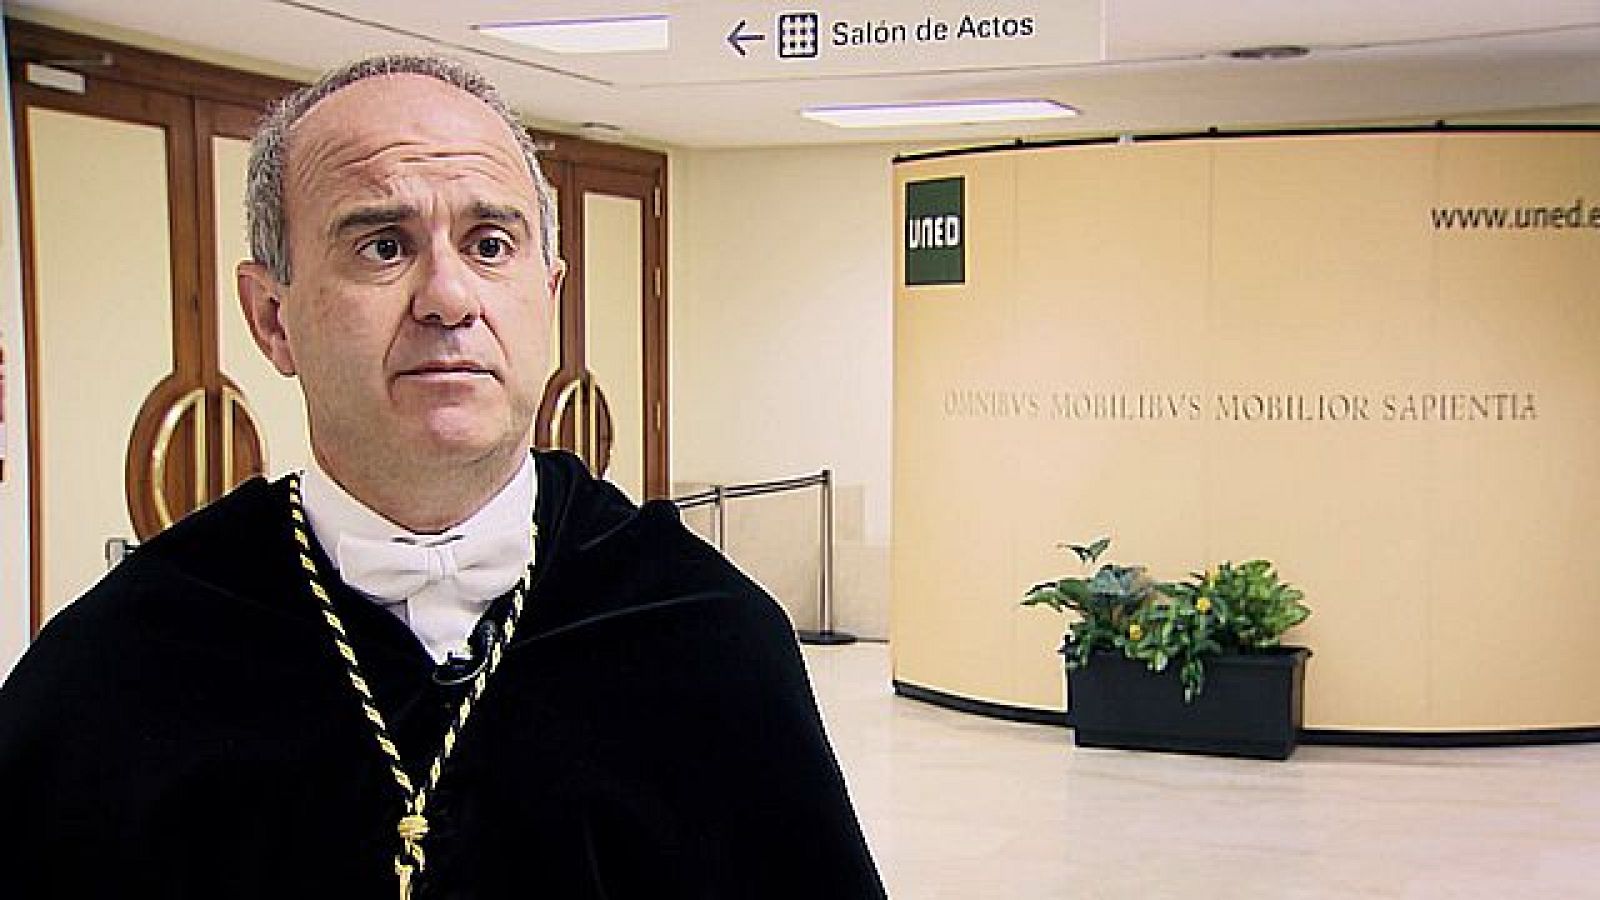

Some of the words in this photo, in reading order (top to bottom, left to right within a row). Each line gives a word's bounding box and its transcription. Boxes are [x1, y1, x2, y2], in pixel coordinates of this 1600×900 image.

[832, 19, 907, 46] Salón
[915, 17, 948, 42] de
[957, 14, 1034, 39] Actos
[1214, 394, 1371, 421] MOBILIOR
[1381, 392, 1539, 421] SAPIENTIA
